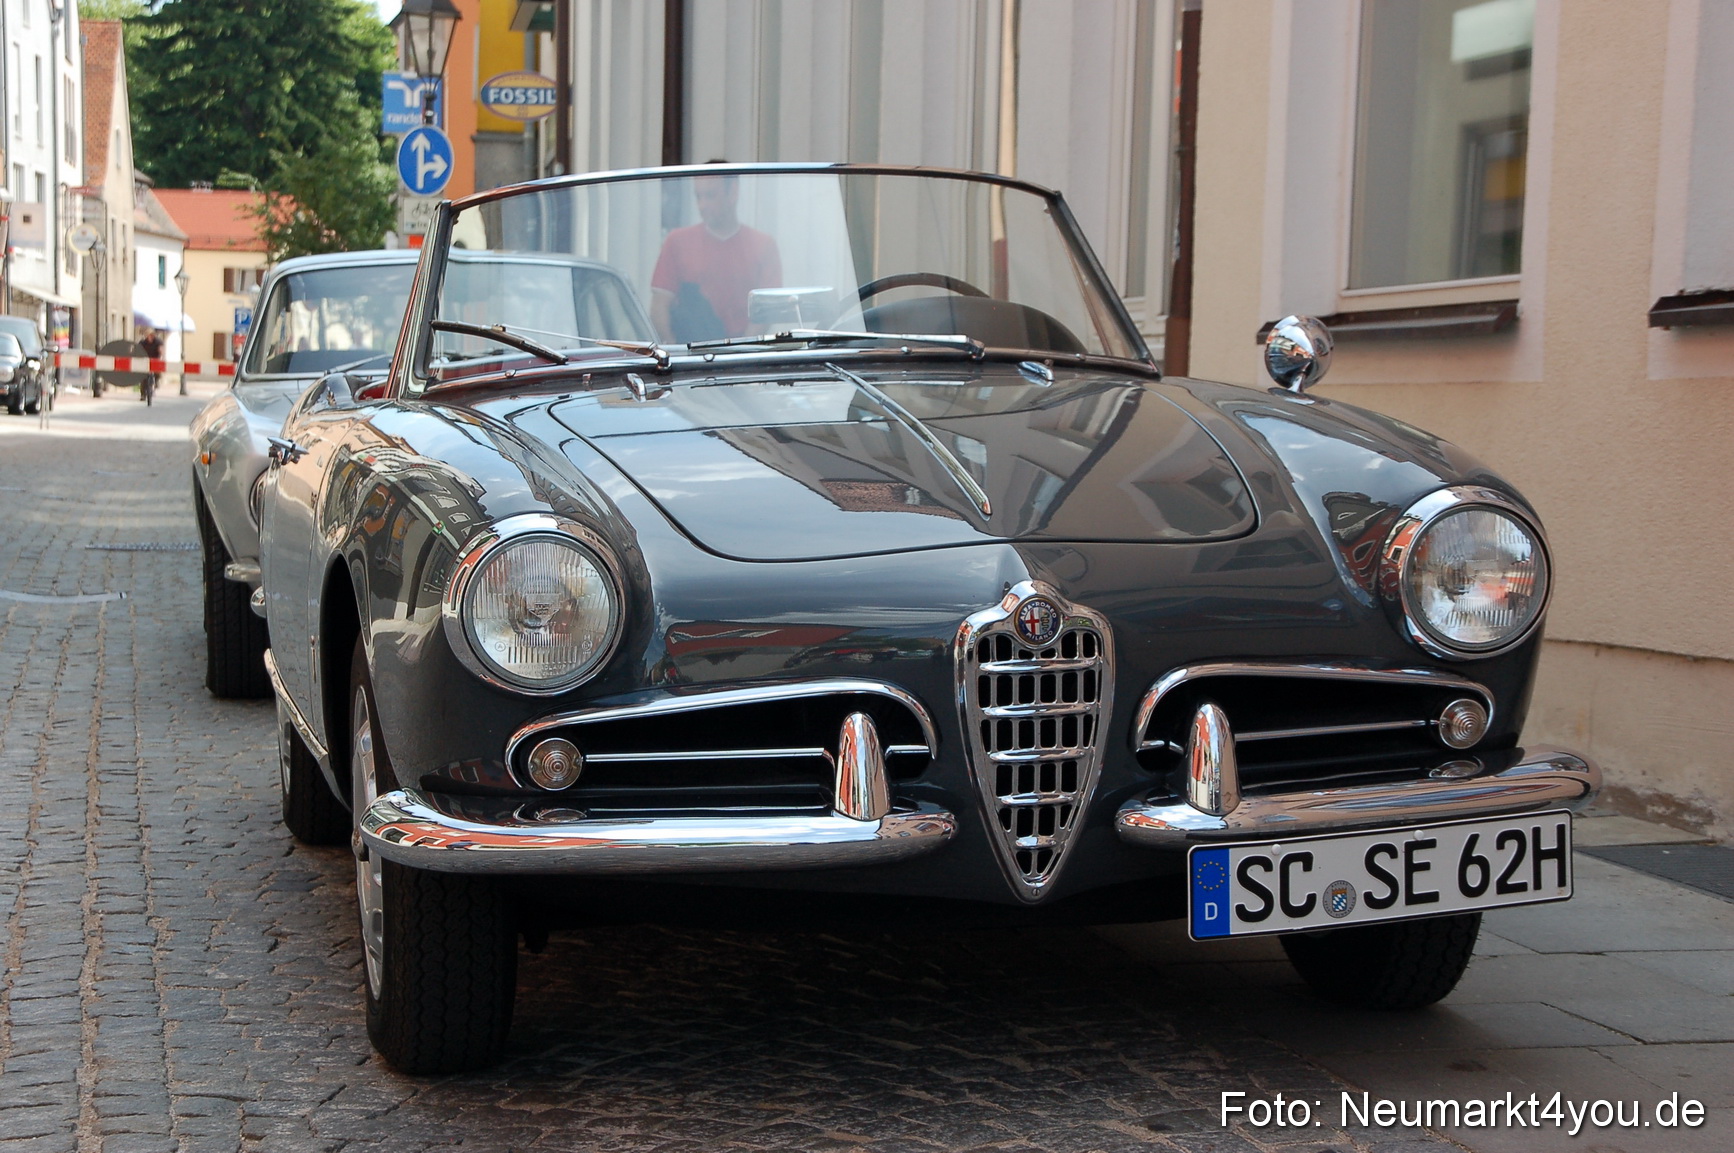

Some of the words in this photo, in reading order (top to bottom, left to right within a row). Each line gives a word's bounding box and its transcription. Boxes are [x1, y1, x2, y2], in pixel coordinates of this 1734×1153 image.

[488, 88, 557, 104] FOSSIL
[1026, 630, 1053, 641] MILANO
[1235, 850, 1318, 922] SC
[1363, 838, 1440, 910] SE
[1457, 823, 1567, 898] 62H
[1204, 902, 1218, 921] D
